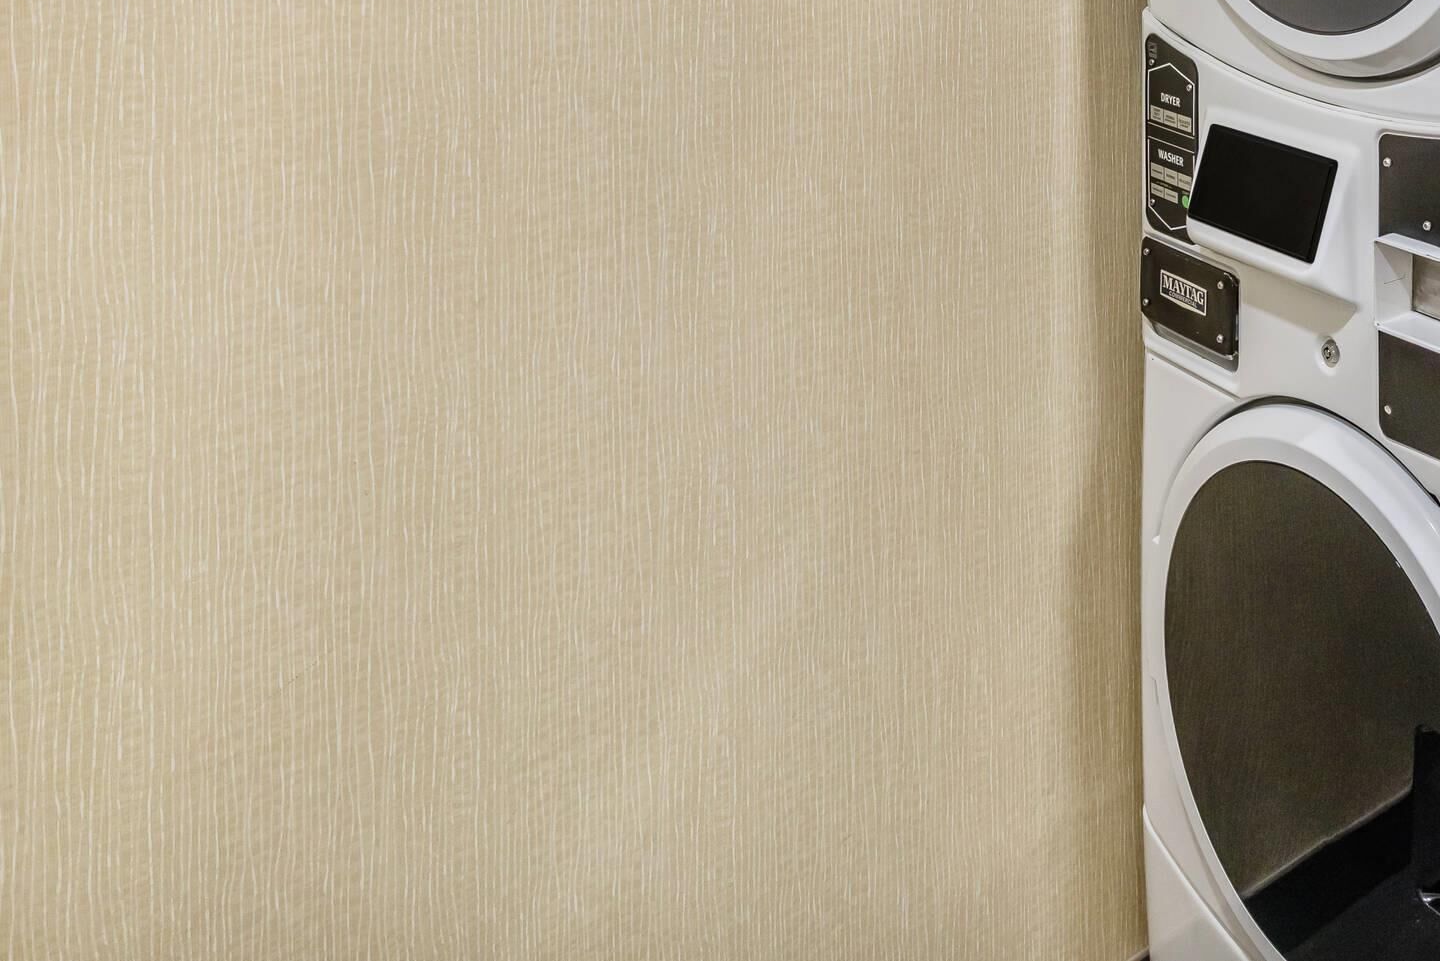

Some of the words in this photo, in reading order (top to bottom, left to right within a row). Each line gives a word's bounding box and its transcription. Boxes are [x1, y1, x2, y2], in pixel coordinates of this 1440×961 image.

[1161, 92, 1181, 108] DRYER
[1157, 148, 1184, 168] WASHER
[1162, 274, 1204, 306] MAYTAG
